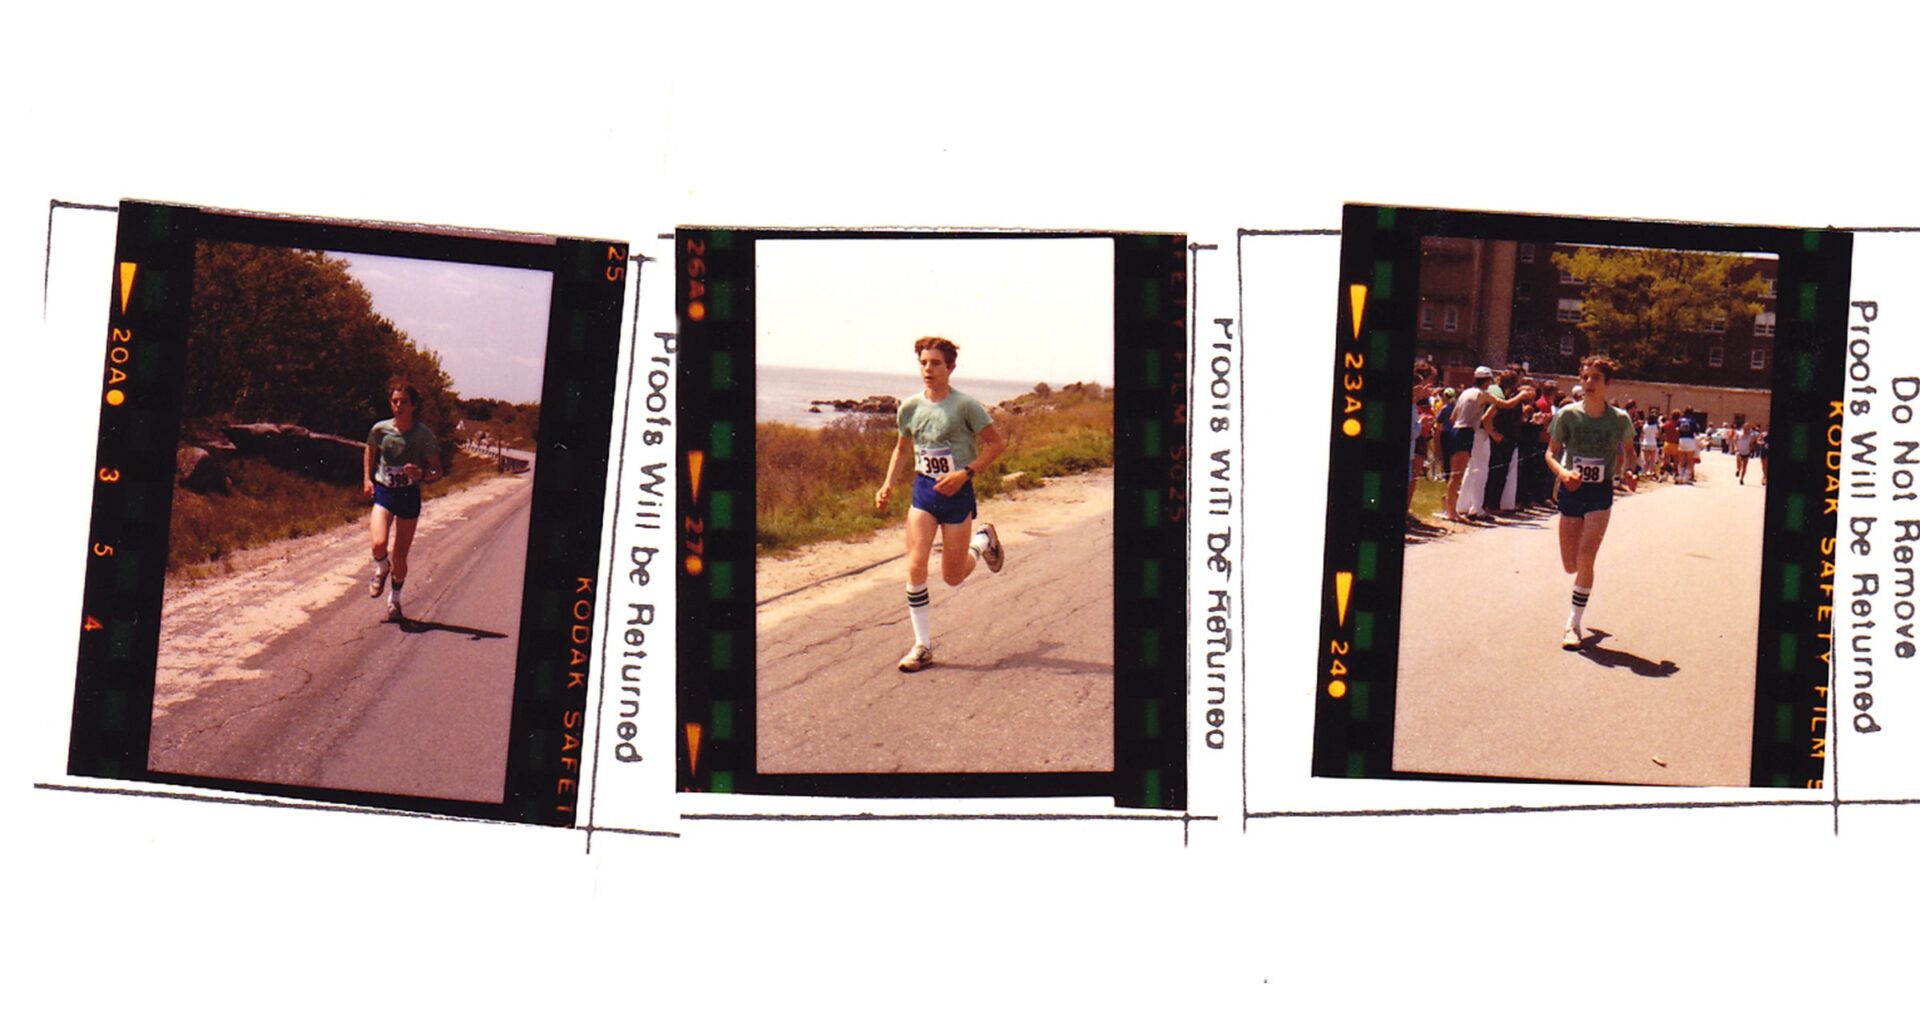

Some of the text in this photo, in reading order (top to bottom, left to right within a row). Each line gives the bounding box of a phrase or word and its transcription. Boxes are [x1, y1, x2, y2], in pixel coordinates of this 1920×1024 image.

[607, 245, 627, 282] 25
[686, 238, 706, 300] 26A
[1170, 351, 1186, 425] FILM
[1343, 352, 1364, 413] 23A
[83, 328, 132, 632] 20A 3 5 4
[923, 457, 950, 474] 398
[1823, 400, 1845, 516] KODAK
[614, 331, 679, 763] Proofs Will be Returned
[1849, 300, 1882, 734] Proofs Will be Returned
[1891, 376, 1920, 659] Do Not Remove
[1330, 640, 1350, 676] 24
[1816, 537, 1838, 665] SAFETY
[556, 576, 593, 829] KODAK SAFET
